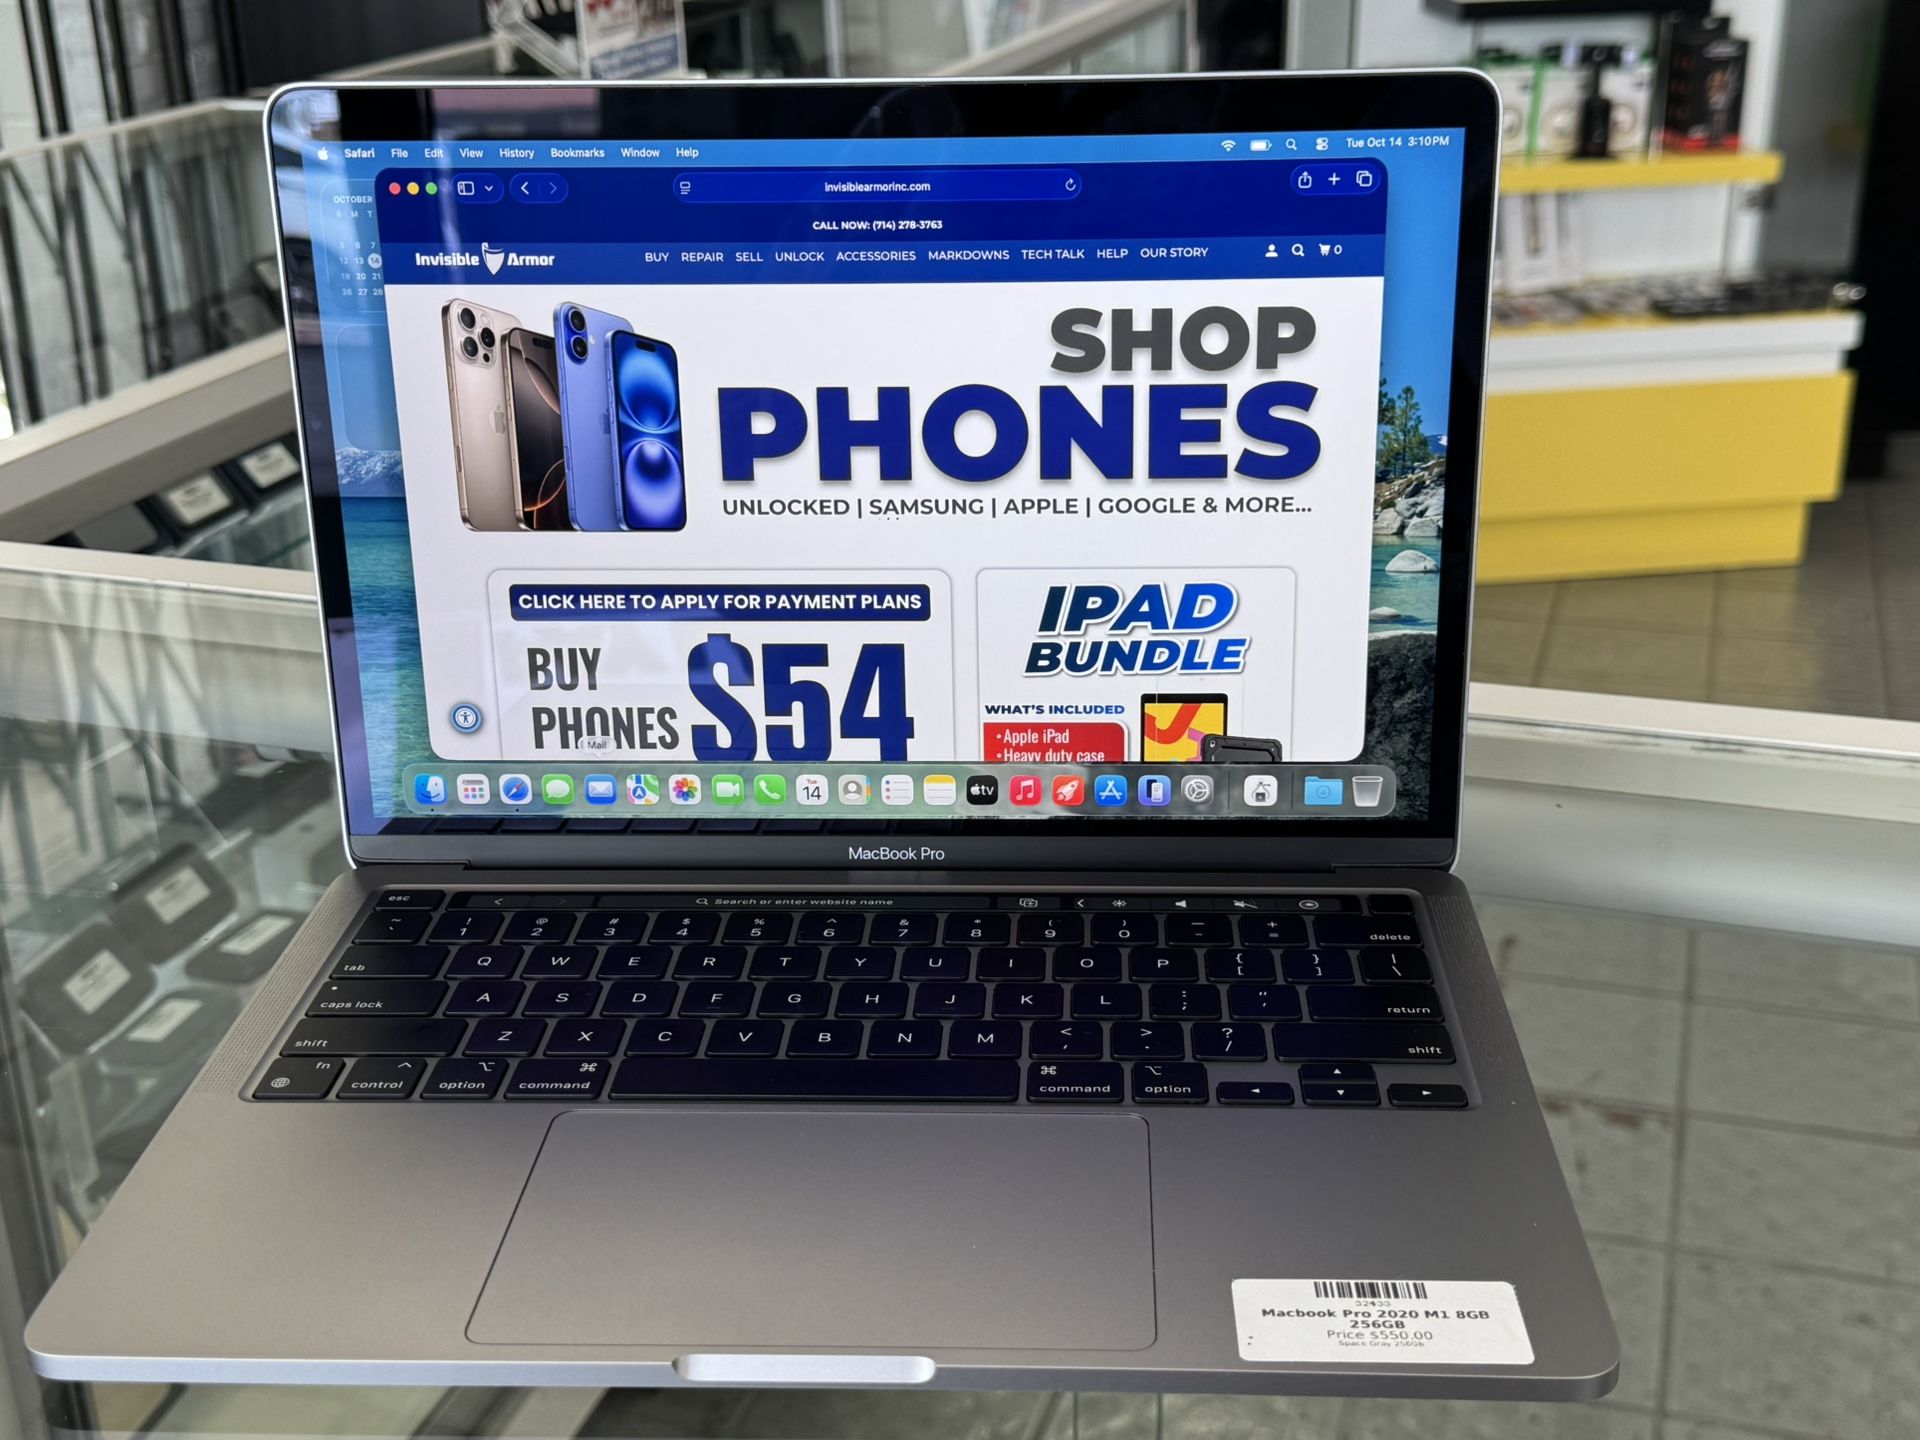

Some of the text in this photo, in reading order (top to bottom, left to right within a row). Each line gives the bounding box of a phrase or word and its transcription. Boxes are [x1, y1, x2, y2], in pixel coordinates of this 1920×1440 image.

[1346, 137, 1365, 148] Tue
[1366, 136, 1386, 148] Oct
[1388, 136, 1402, 147] 14
[344, 147, 699, 160] Safari File Edit View History Bookmarks Window Help
[824, 181, 931, 193] invisiblearmorinc.com
[333, 195, 373, 204] OCTOBER
[812, 219, 943, 232] CALL NOW: (714) 278-3763
[927, 250, 1010, 261] MARKDOWNS
[1021, 248, 1086, 260] TECH TALK
[1096, 248, 1129, 259] HELP
[1140, 247, 1209, 259] OUR STORY
[1333, 244, 1343, 256] 0
[415, 252, 555, 266] Invisible Armor
[645, 252, 670, 263] BUY
[680, 252, 724, 263] REPAIR
[735, 252, 764, 263] SELL
[774, 251, 825, 262] UNLOCK
[836, 250, 917, 262] ACCESSORIES
[1050, 305, 1316, 373] SHOP
[717, 380, 1321, 482] PHONES
[723, 499, 850, 516] UNLOCKED
[869, 499, 984, 515] SAMSUNG
[1004, 499, 1078, 515] APPLE
[1099, 497, 1195, 514] GOOGLE
[1202, 497, 1217, 514] &
[1225, 497, 1312, 514] MORE...
[518, 594, 921, 610] CLICK HERE TO APPLY FOR PAYMENT PLANS
[1037, 583, 1236, 632] IPAD
[1024, 637, 1248, 674] BUNDLE
[527, 647, 602, 691] BUY
[688, 633, 915, 762] $54
[1048, 704, 1125, 715] INCLUDED
[532, 706, 679, 750] PHONES
[1004, 728, 1070, 746] Apple iPad
[587, 740, 607, 749] Mail
[1076, 751, 1105, 762] case
[803, 786, 822, 800] 14
[848, 848, 945, 860] MacBook Pro
[530, 928, 542, 937] 2
[603, 928, 616, 937] 3
[676, 928, 689, 937] 4
[749, 928, 762, 937] 5
[823, 928, 836, 937] 6
[898, 928, 909, 938] 7
[970, 928, 982, 938] 8
[1044, 928, 1056, 938] 9
[1118, 929, 1130, 939] 0
[1369, 933, 1411, 941] delete
[477, 956, 492, 967] Q
[550, 956, 571, 967] W
[628, 956, 641, 967] E
[703, 956, 716, 967] R
[779, 956, 792, 967] T
[854, 957, 868, 968] Y
[928, 957, 942, 968] U
[1080, 957, 1094, 969] O
[1157, 958, 1170, 969] P
[343, 963, 365, 972] tab
[476, 992, 491, 1003] A
[555, 992, 569, 1003] S
[631, 992, 647, 1003] D
[710, 993, 724, 1004] F
[787, 993, 802, 1004] G
[864, 993, 880, 1004] H
[944, 993, 956, 1005] J
[1020, 994, 1034, 1005] K
[1100, 994, 1112, 1005] L
[320, 1000, 384, 1010] caps lock
[1387, 1006, 1431, 1014] return
[497, 1030, 513, 1042] Z
[577, 1030, 594, 1042] X
[657, 1031, 673, 1042] C
[738, 1031, 753, 1043] V
[818, 1032, 831, 1043] B
[897, 1032, 912, 1043] N
[977, 1032, 994, 1044] M
[294, 1038, 329, 1048] shift
[1407, 1045, 1443, 1055] shift
[315, 1061, 331, 1070] fn
[351, 1080, 403, 1089] control
[439, 1080, 485, 1090] option
[518, 1080, 591, 1090] command
[1039, 1084, 1111, 1093] command
[1144, 1085, 1191, 1094] option
[1261, 1308, 1490, 1320] Macbook Pro 2020 M1 8GB
[1349, 1320, 1406, 1329] 256GB
[1326, 1329, 1434, 1341] Price $550.00
